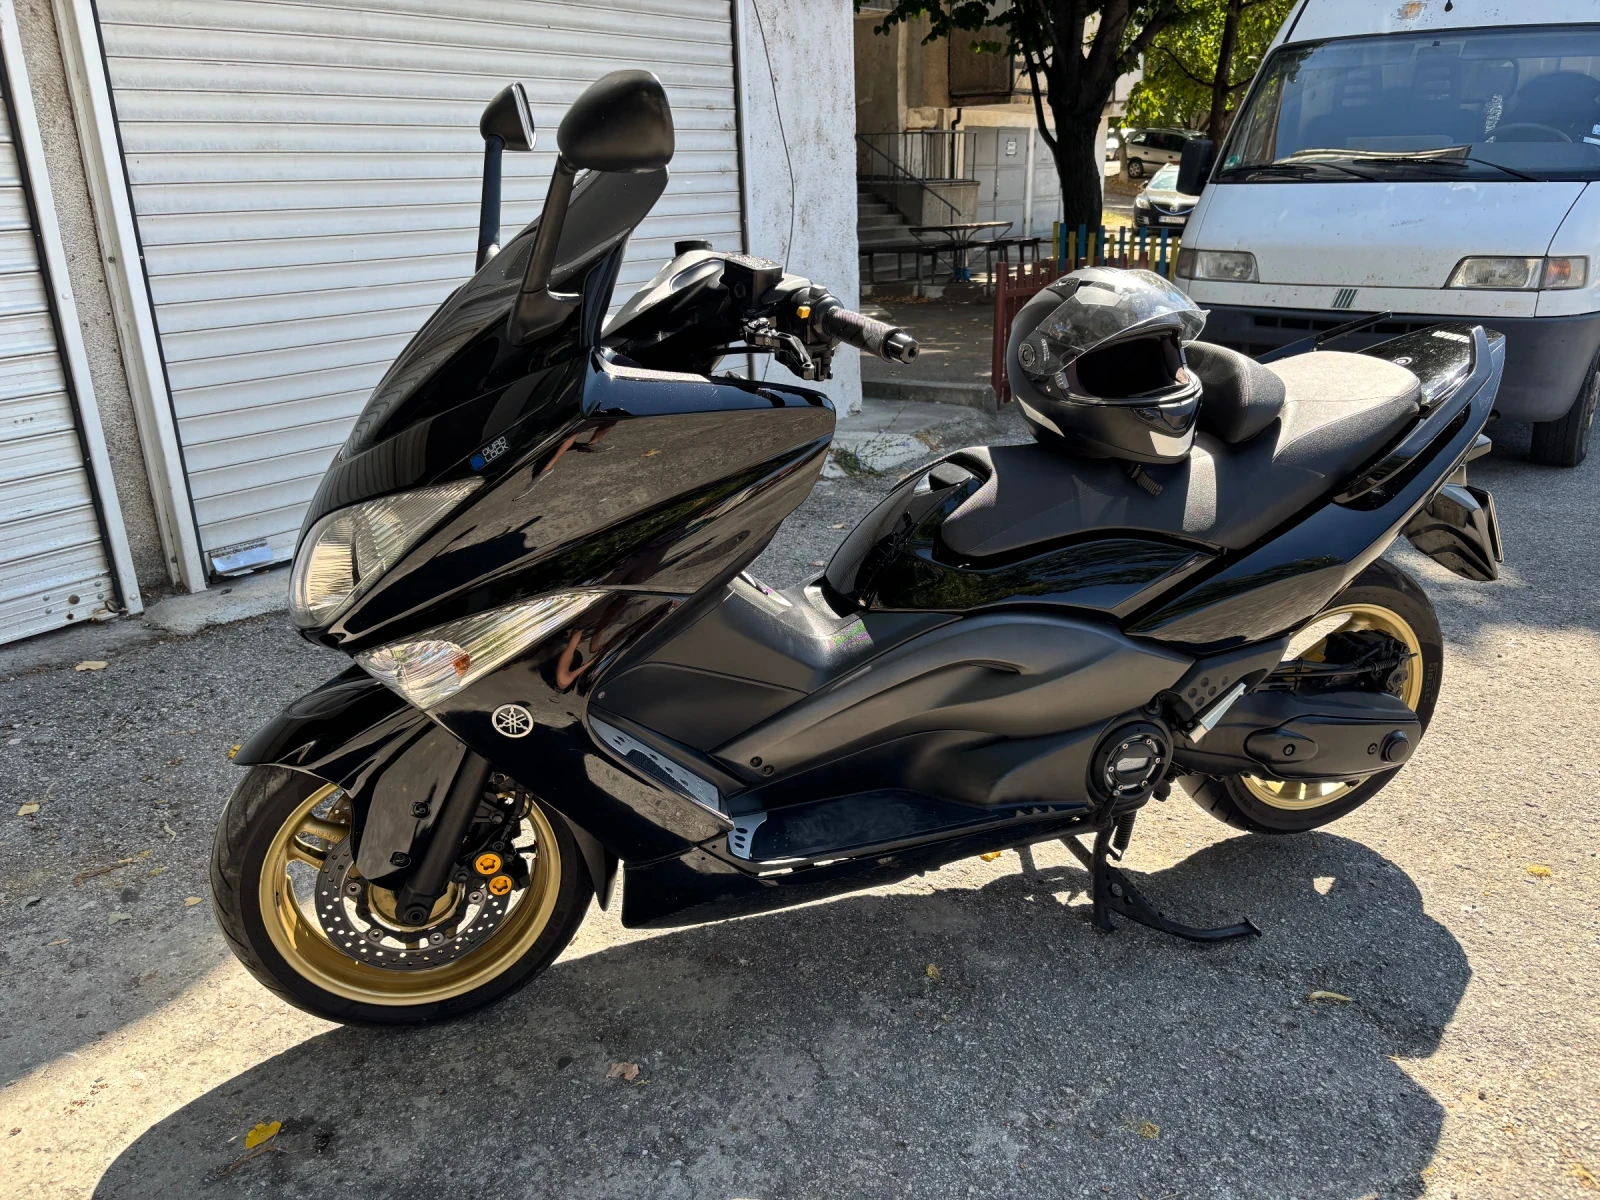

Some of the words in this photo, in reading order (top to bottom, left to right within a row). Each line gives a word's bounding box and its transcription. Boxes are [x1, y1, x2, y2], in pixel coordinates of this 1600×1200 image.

[482, 436, 506, 456] QUAD
[484, 442, 509, 462] LOCK
[1423, 662, 1439, 704] PIRELLI
